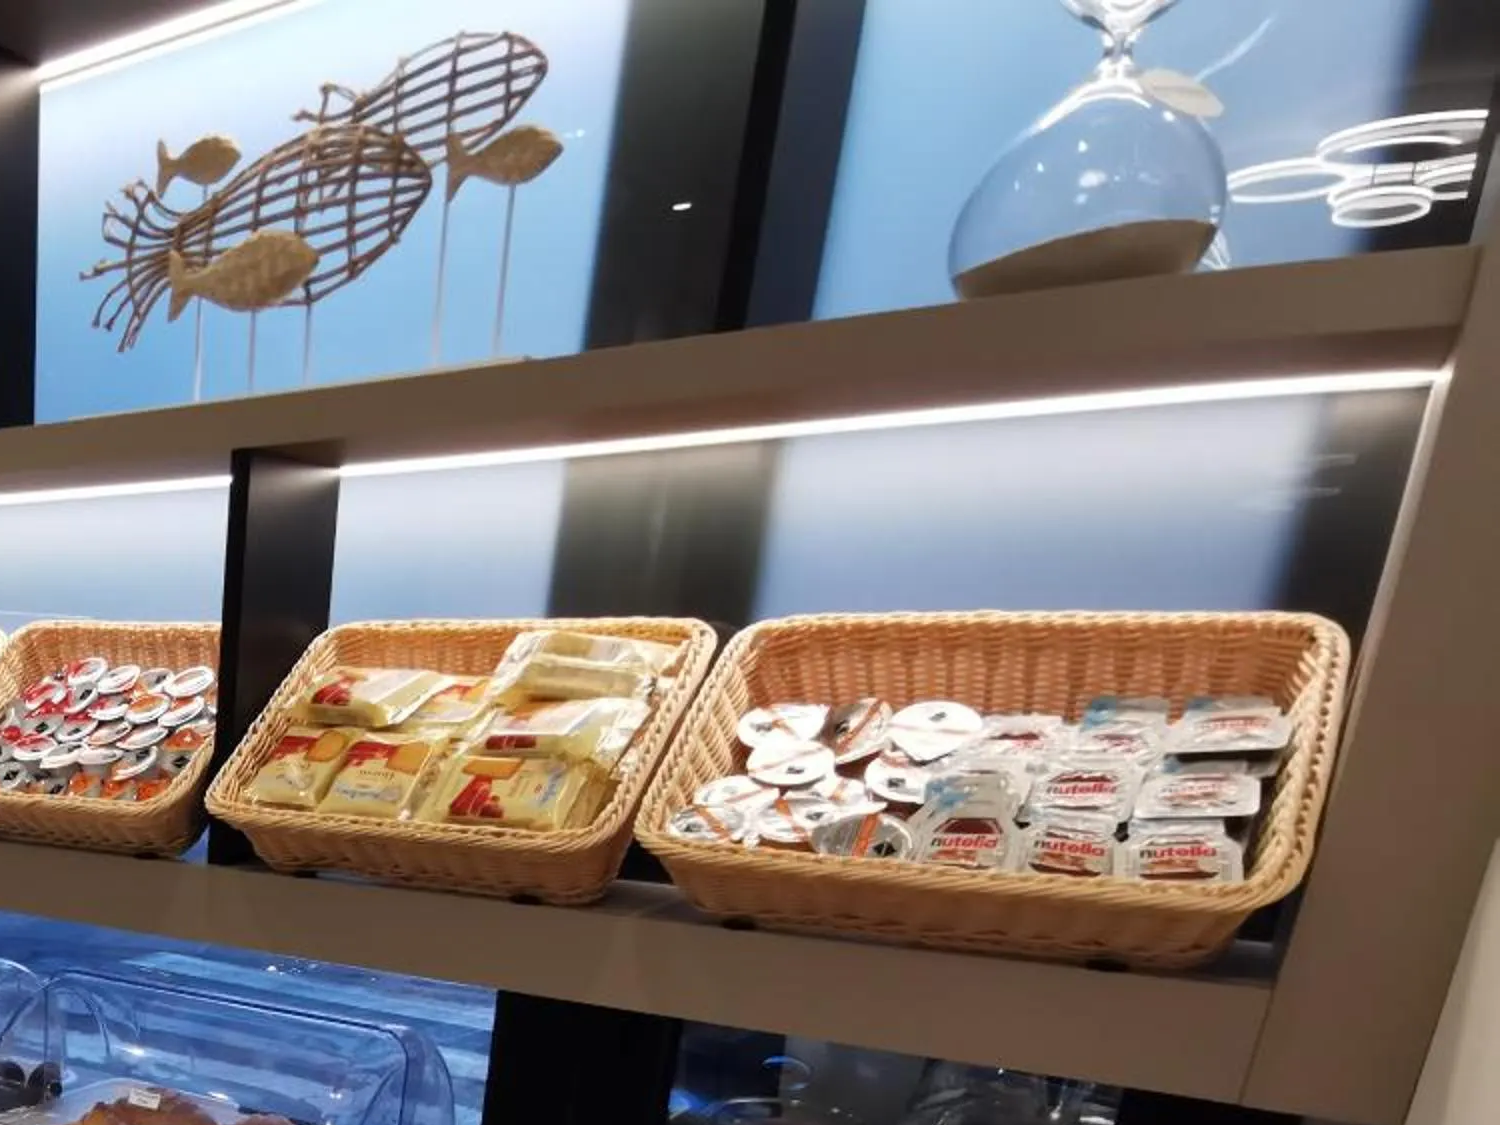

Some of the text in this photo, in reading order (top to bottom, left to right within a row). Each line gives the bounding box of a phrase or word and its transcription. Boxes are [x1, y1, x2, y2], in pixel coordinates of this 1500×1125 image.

[930, 835, 998, 849] nutella
[1033, 838, 1106, 857] nutella
[1139, 845, 1217, 858] nutella
